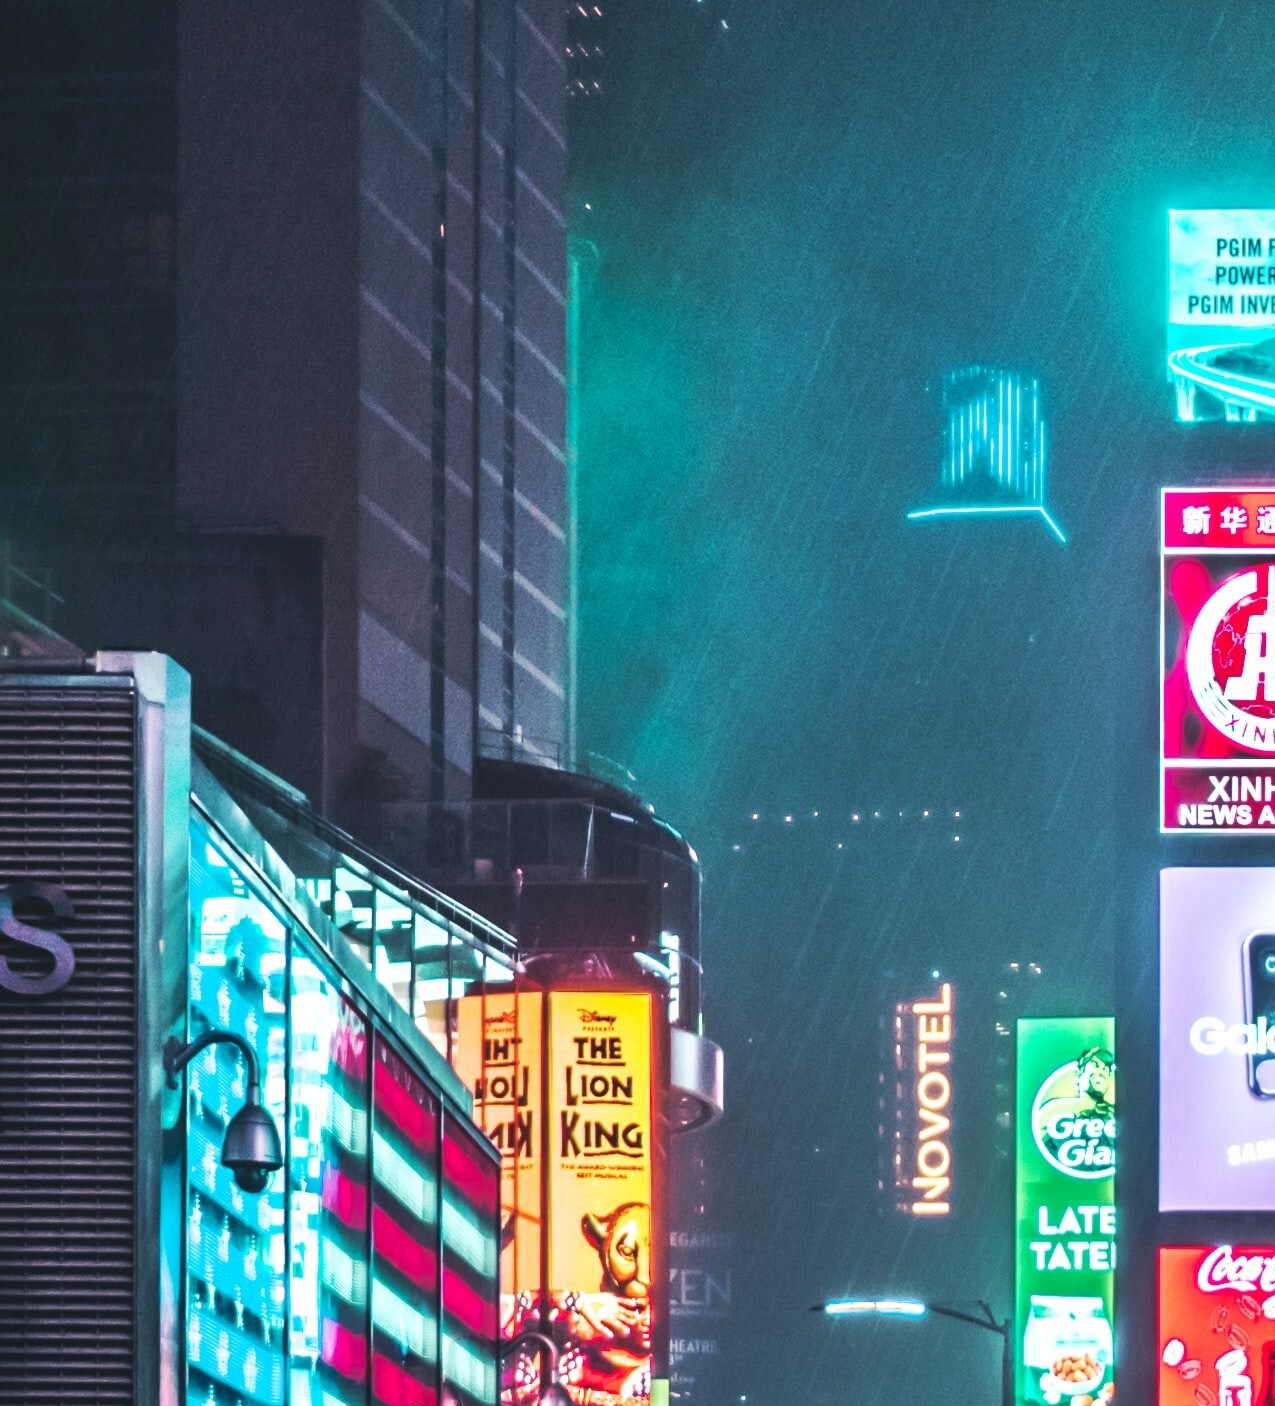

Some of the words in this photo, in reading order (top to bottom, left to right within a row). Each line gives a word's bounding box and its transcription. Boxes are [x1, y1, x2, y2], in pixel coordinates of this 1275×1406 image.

[1216, 238, 1262, 257] PGIM
[1188, 295, 1234, 314] PGIM
[1178, 803, 1253, 826] NEWS
[574, 1037, 621, 1060] THE
[566, 1066, 633, 1106] LION
[911, 982, 951, 1215] NOVOTEL
[561, 1110, 643, 1158] KING
[1047, 1111, 1116, 1139] Gree
[1057, 1139, 1116, 1167] Gia
[1038, 1205, 1116, 1235] LATE
[1030, 1241, 1116, 1270] TATE
